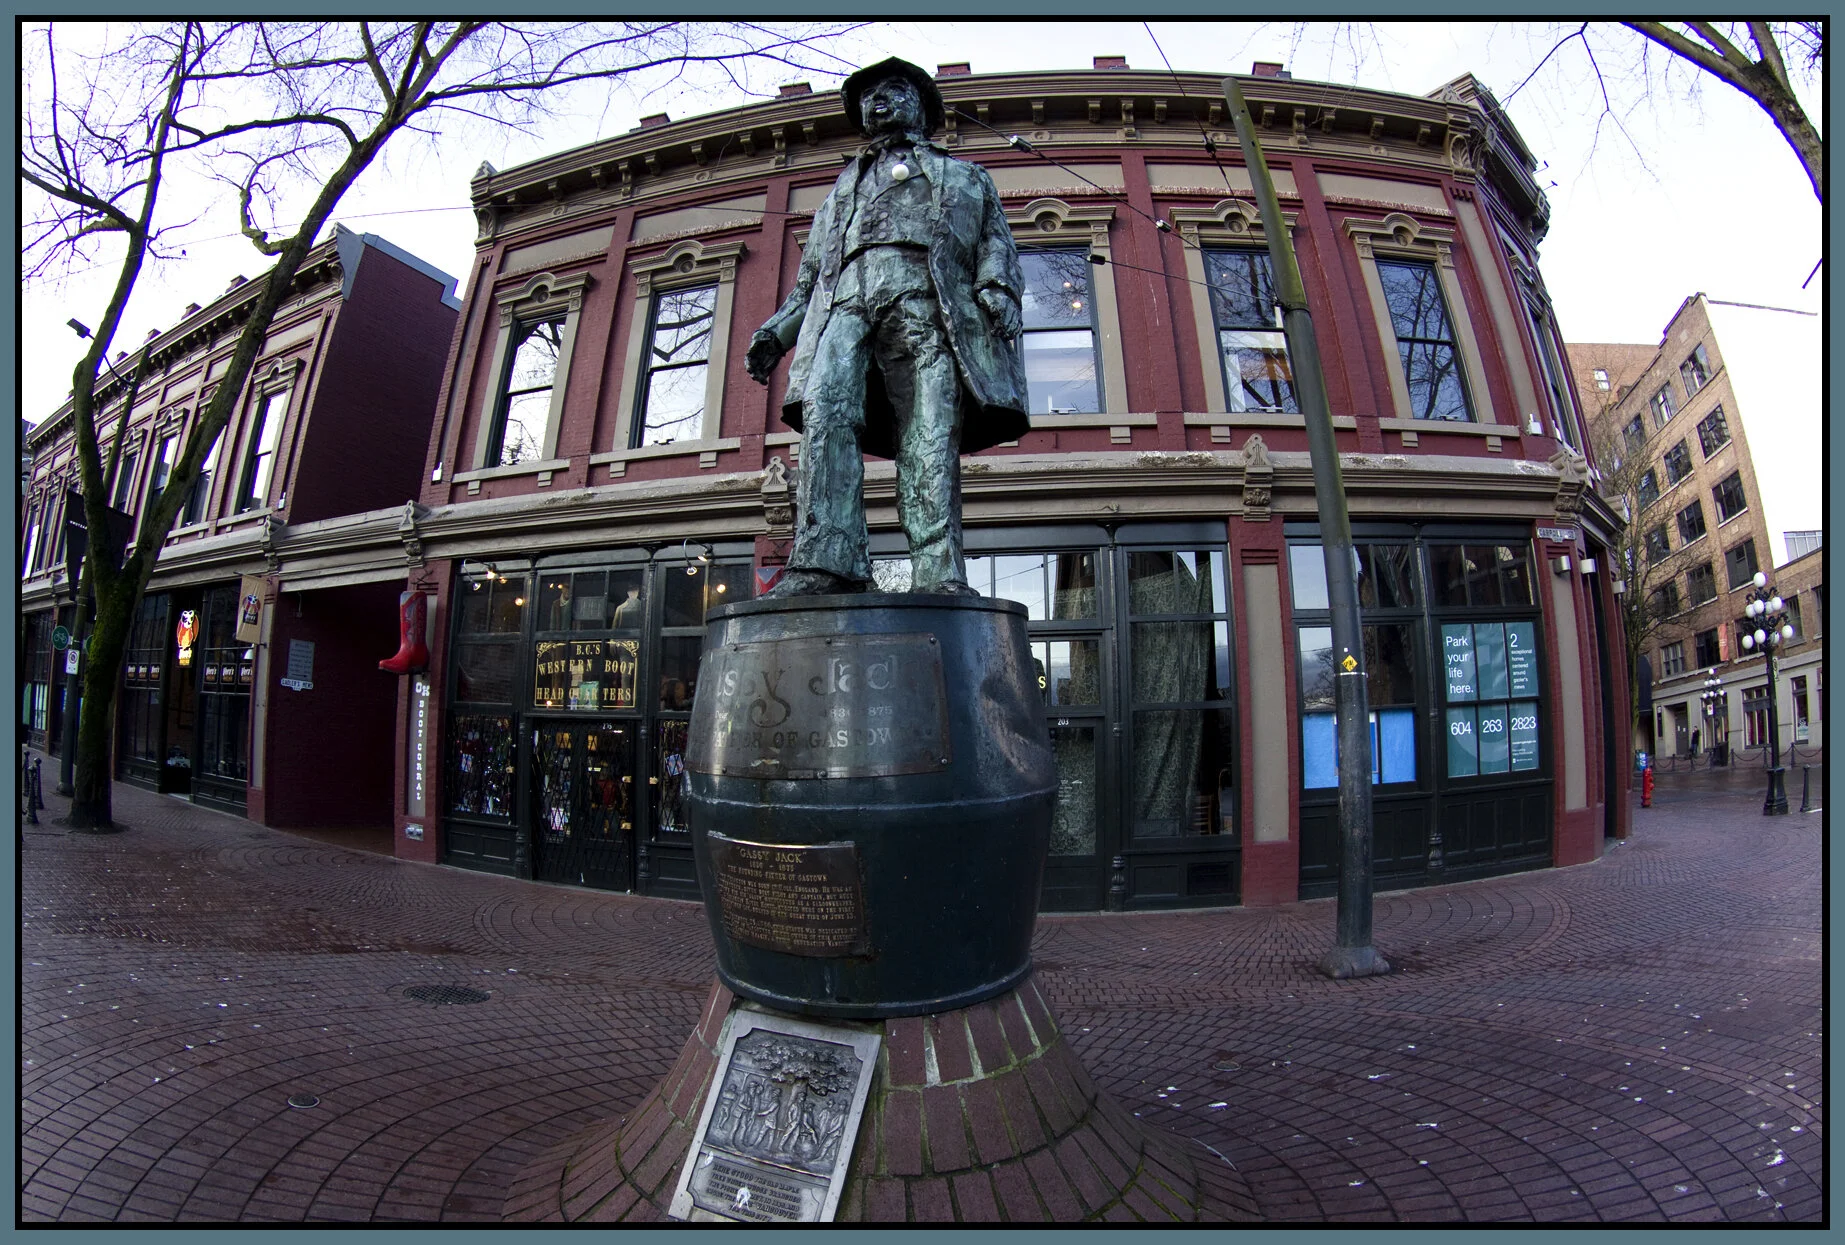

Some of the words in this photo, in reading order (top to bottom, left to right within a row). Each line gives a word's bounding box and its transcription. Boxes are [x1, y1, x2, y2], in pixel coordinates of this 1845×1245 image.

[1446, 636, 1469, 647] Park
[1510, 633, 1518, 648] 2
[1447, 652, 1469, 664] your
[538, 658, 593, 676] WESTERN
[604, 659, 635, 675] BOOT
[1449, 667, 1463, 678] life
[415, 682, 430, 697] OK
[1450, 683, 1474, 694] here.
[1451, 721, 1472, 736] 604
[1482, 719, 1503, 734] 263
[1511, 716, 1537, 731] 2823
